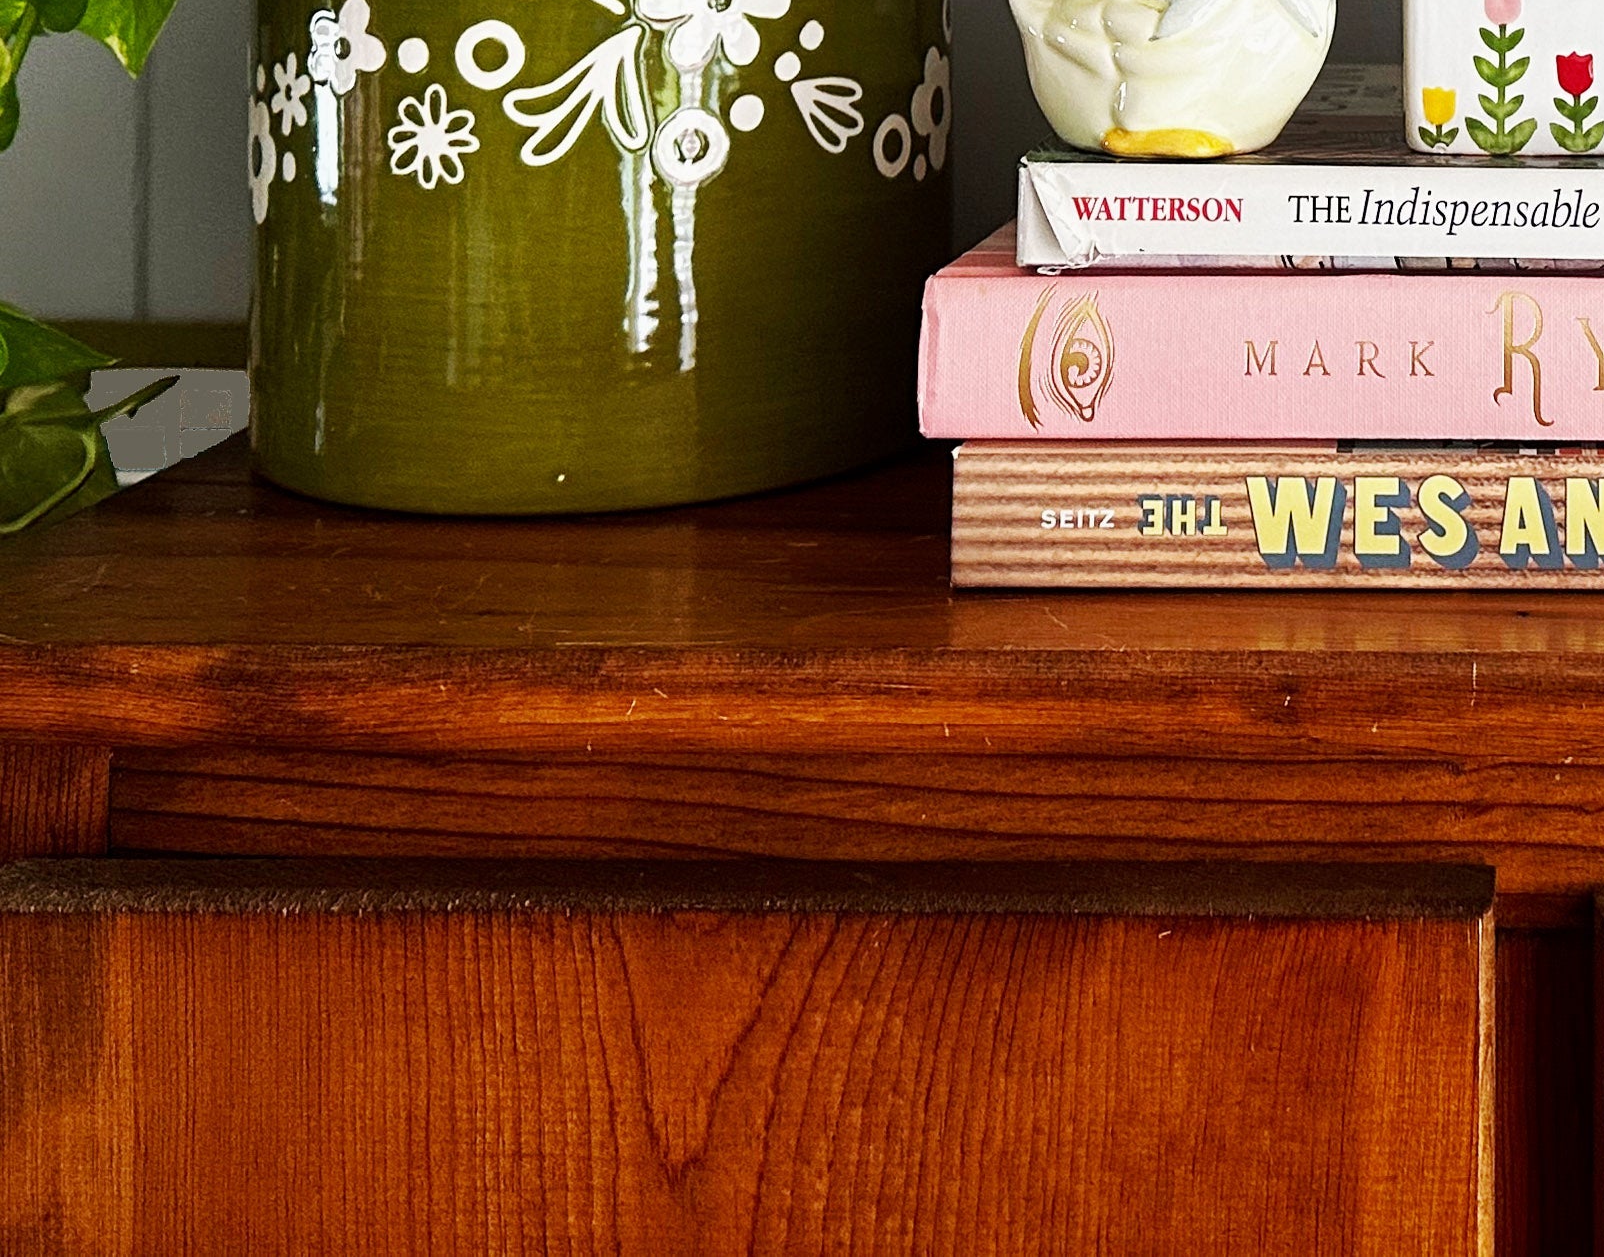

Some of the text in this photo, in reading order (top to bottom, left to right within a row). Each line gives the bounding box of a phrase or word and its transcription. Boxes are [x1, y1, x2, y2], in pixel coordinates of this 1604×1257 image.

[1071, 196, 1243, 223] WATTERSON
[1287, 195, 1350, 224] THE
[1358, 187, 1601, 235] Indispensable
[1244, 340, 1436, 377] MARK
[1040, 509, 1116, 529] SEITZ
[1137, 494, 1228, 536] THE
[1245, 474, 1480, 570] WES
